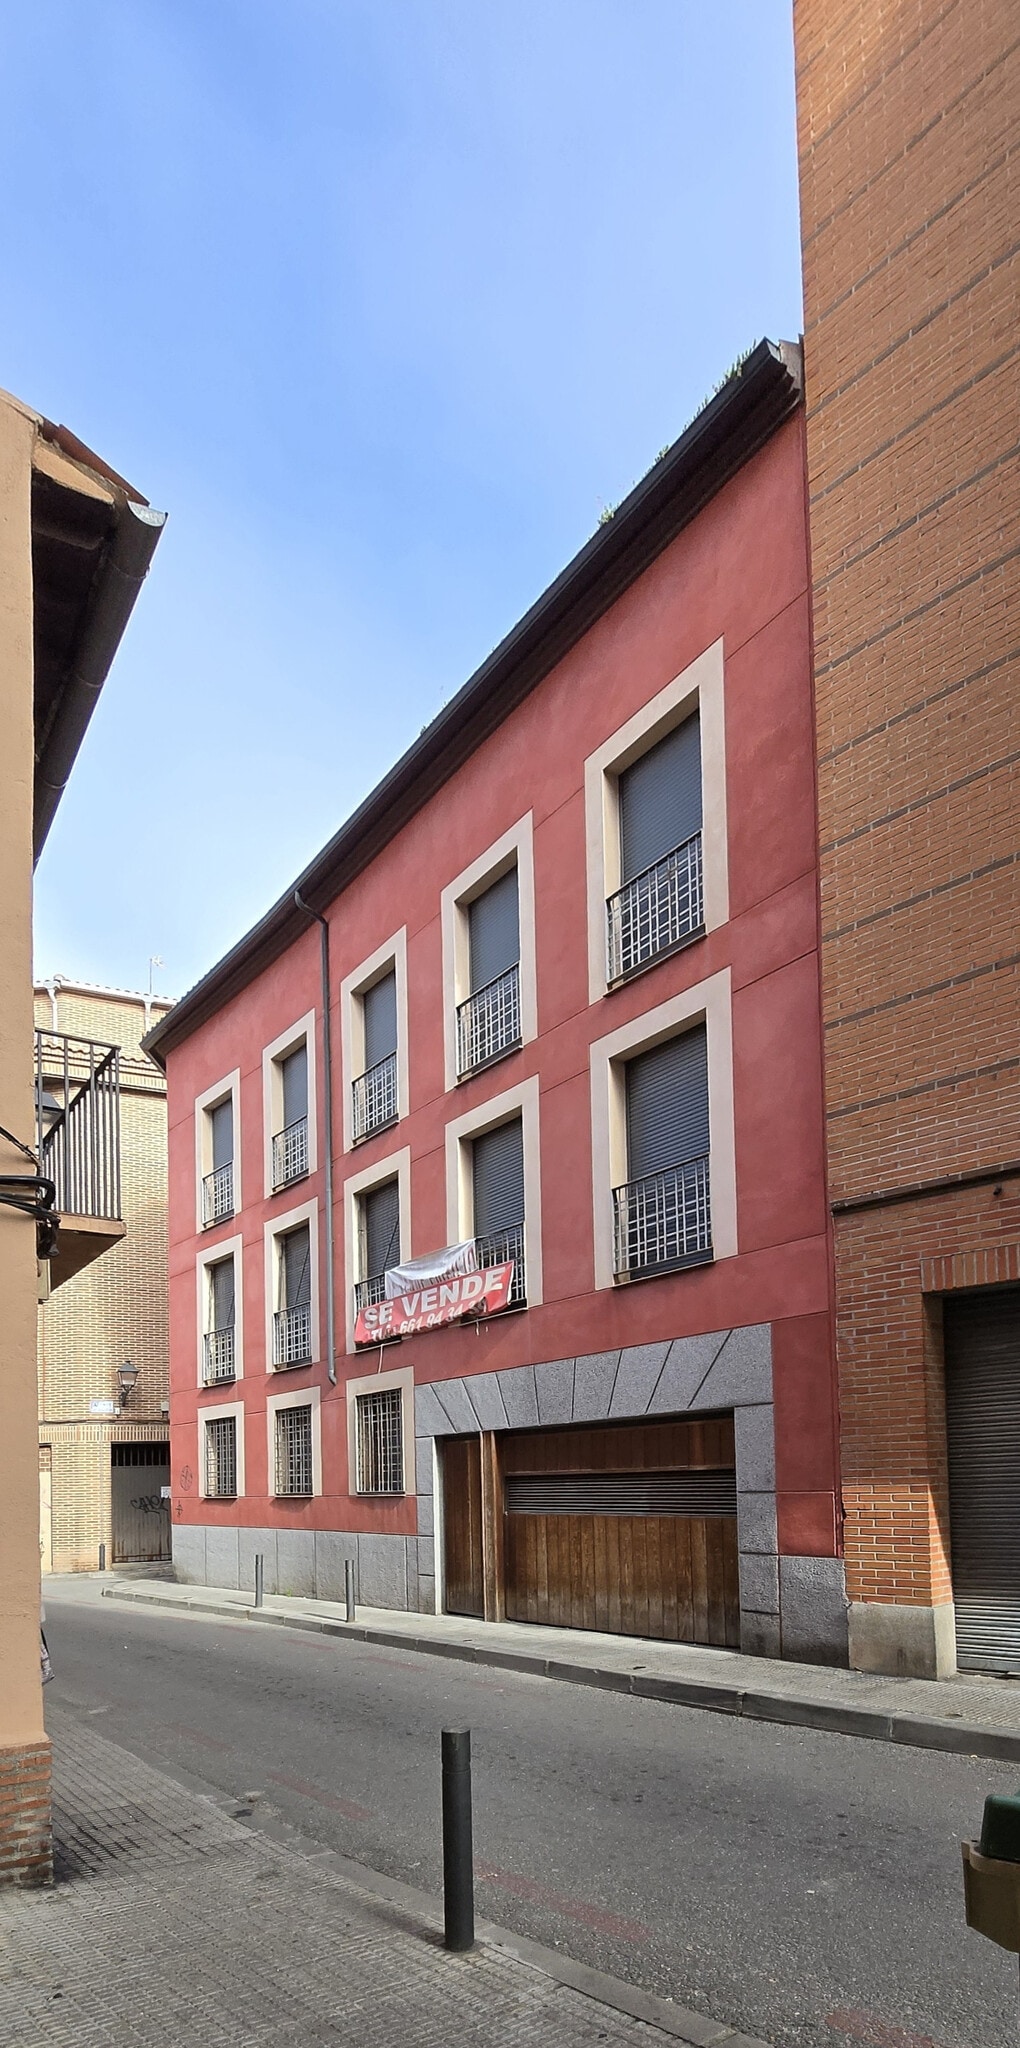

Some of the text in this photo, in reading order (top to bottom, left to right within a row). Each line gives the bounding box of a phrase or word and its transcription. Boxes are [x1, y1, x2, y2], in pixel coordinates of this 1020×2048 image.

[364, 1301, 394, 1330] SE
[401, 1267, 506, 1317] VENDE
[400, 1316, 423, 1335] 661
[426, 1310, 444, 1328] 94
